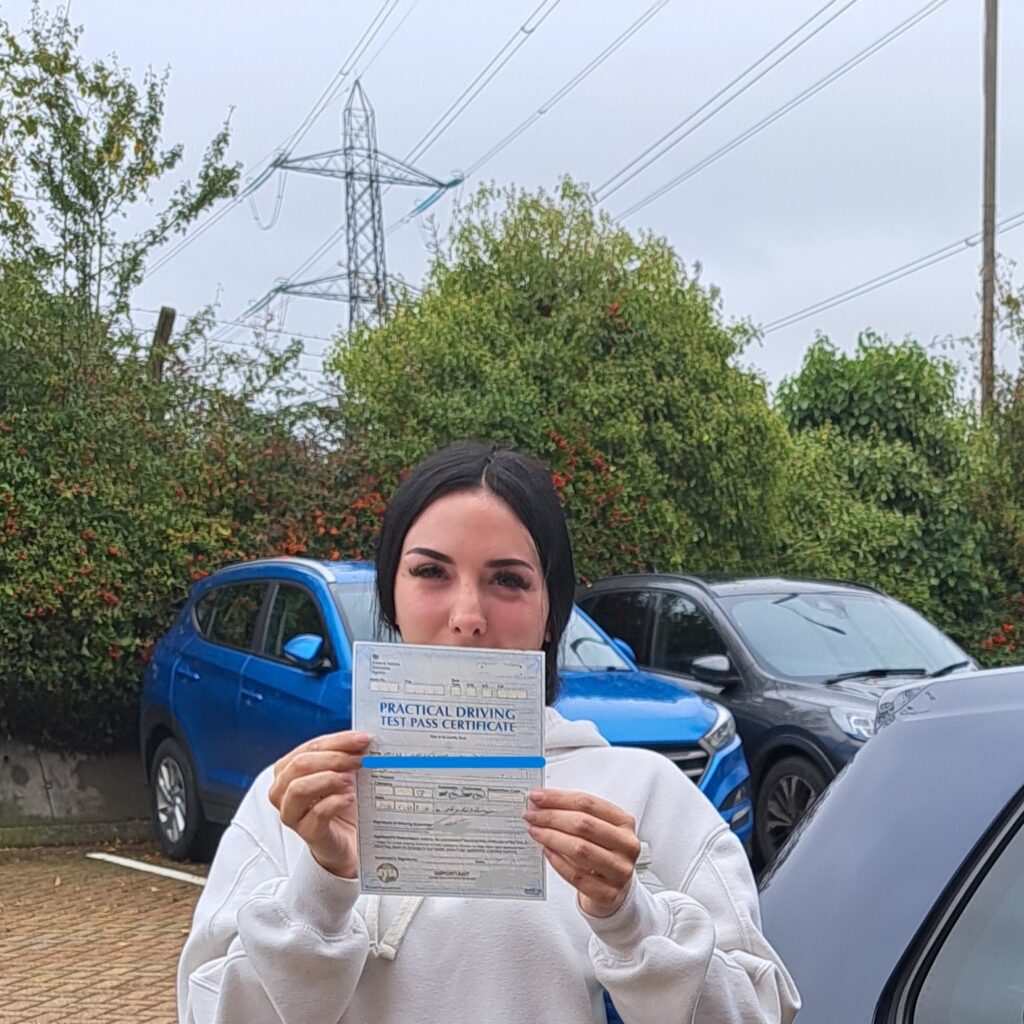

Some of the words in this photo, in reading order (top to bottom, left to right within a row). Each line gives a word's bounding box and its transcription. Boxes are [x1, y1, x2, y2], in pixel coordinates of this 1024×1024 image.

[380, 702, 452, 717] PRACTICAL
[456, 706, 516, 720] DRIVING
[380, 716, 407, 727] TEST
[410, 718, 439, 729] PASS
[442, 720, 516, 732] CERTIFICATE
